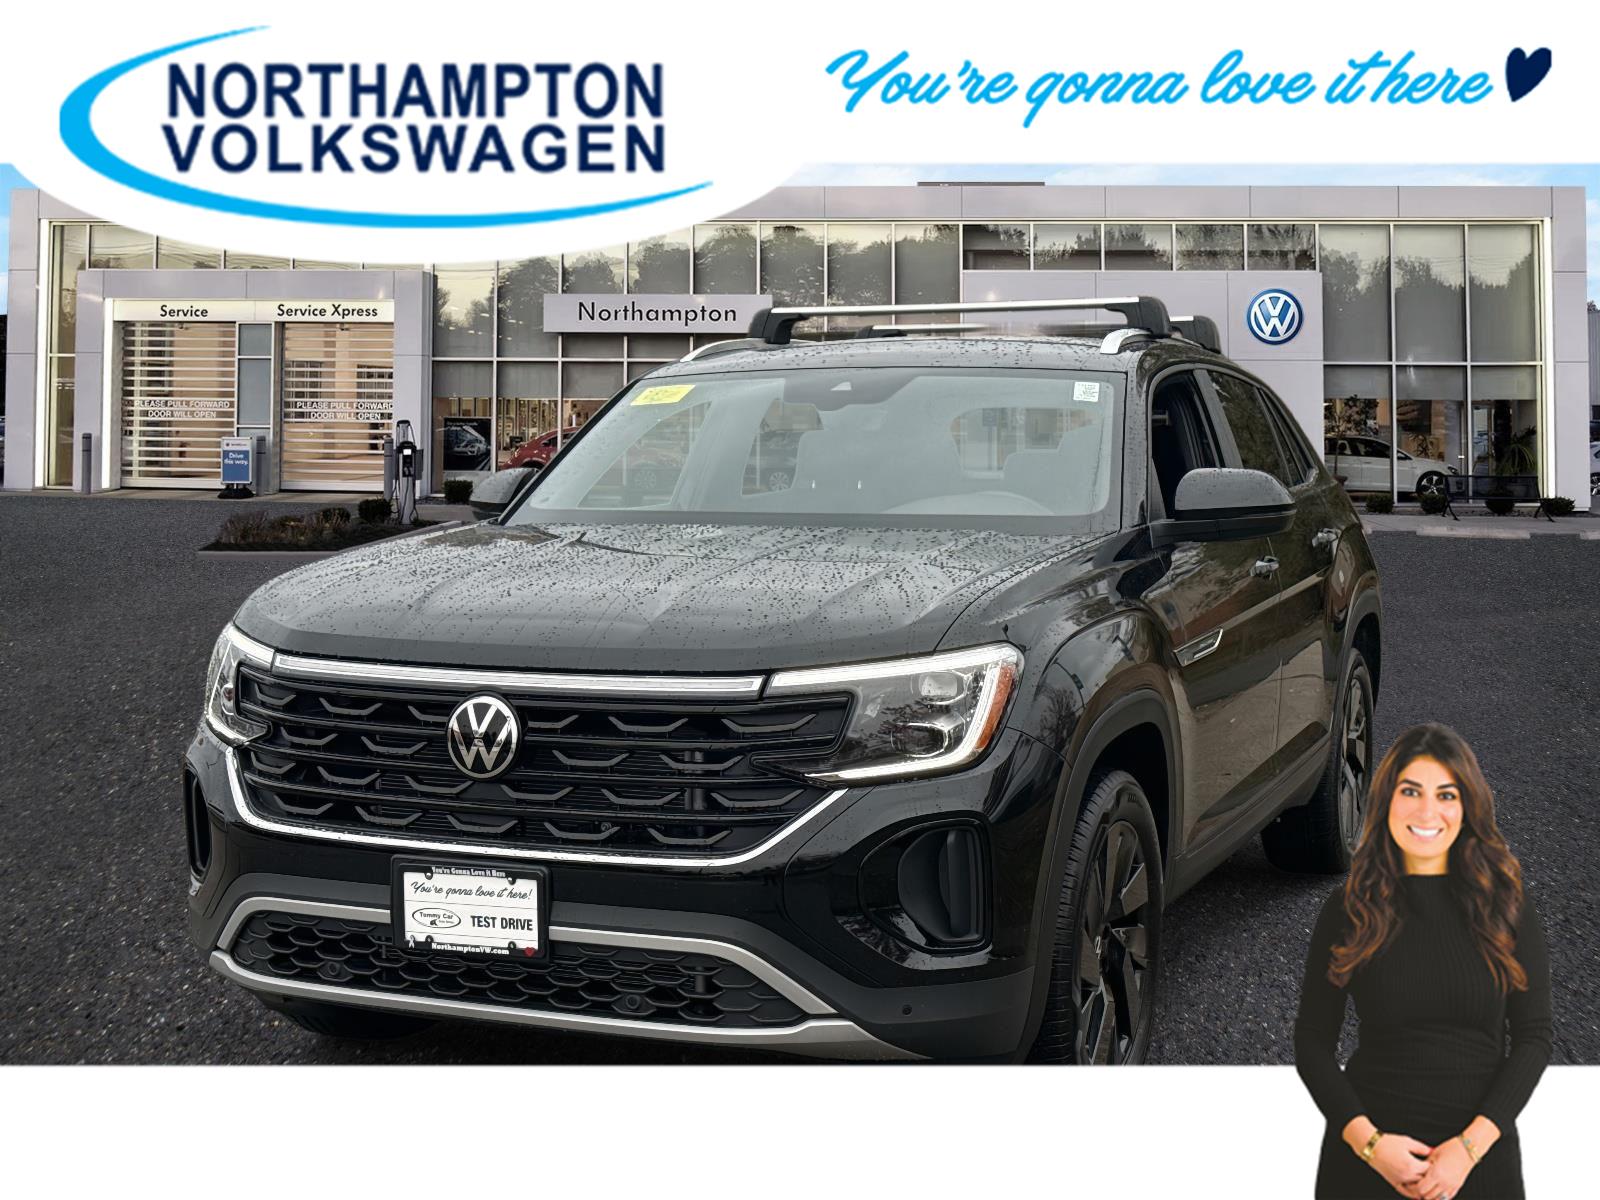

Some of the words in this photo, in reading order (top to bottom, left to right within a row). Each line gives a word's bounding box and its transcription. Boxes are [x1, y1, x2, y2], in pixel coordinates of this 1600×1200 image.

[160, 304, 209, 318] Service
[277, 303, 327, 317] Service
[331, 303, 379, 321] Xpress
[578, 300, 737, 327] Northampton
[135, 400, 166, 408] PLEASE
[189, 401, 230, 409] FORWARD
[296, 401, 328, 409] PLEASE
[353, 402, 393, 410] FORWARD
[148, 410, 171, 418] DOOR
[194, 411, 217, 419] OPEN
[310, 412, 335, 420] DOOR
[336, 412, 356, 420] WILL
[357, 412, 381, 420] OPEN
[410, 881, 443, 895] You're
[445, 887, 474, 899] gonna
[475, 886, 496, 897] love
[497, 887, 508, 897] it
[507, 888, 533, 900] here!
[442, 912, 454, 920] Car
[470, 915, 498, 928] TEST
[500, 917, 534, 931] DRIVE
[431, 942, 510, 955] NorthamptonVW.com
